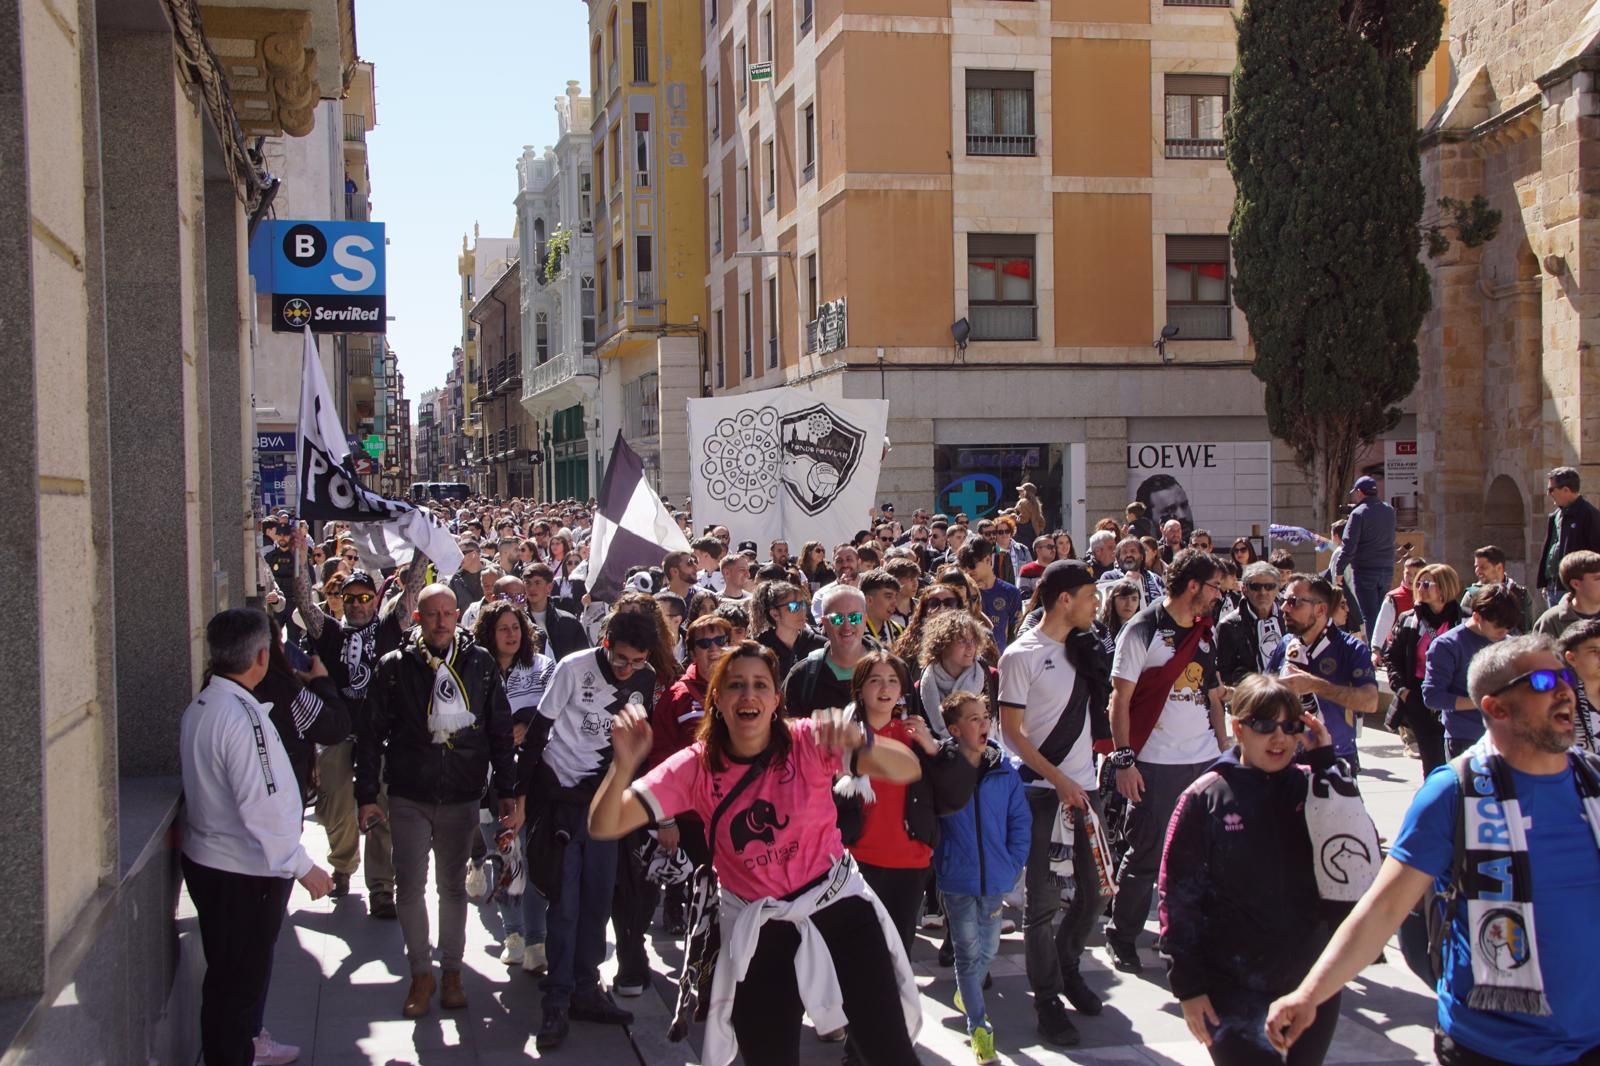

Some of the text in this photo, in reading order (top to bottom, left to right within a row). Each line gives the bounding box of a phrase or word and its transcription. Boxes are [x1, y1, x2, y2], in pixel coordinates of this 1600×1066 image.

[295, 234, 315, 257] B
[330, 235, 377, 291] S
[314, 306, 380, 320] ServiRed
[1127, 444, 1217, 469] LOEWE
[1477, 856, 1513, 902] LA
